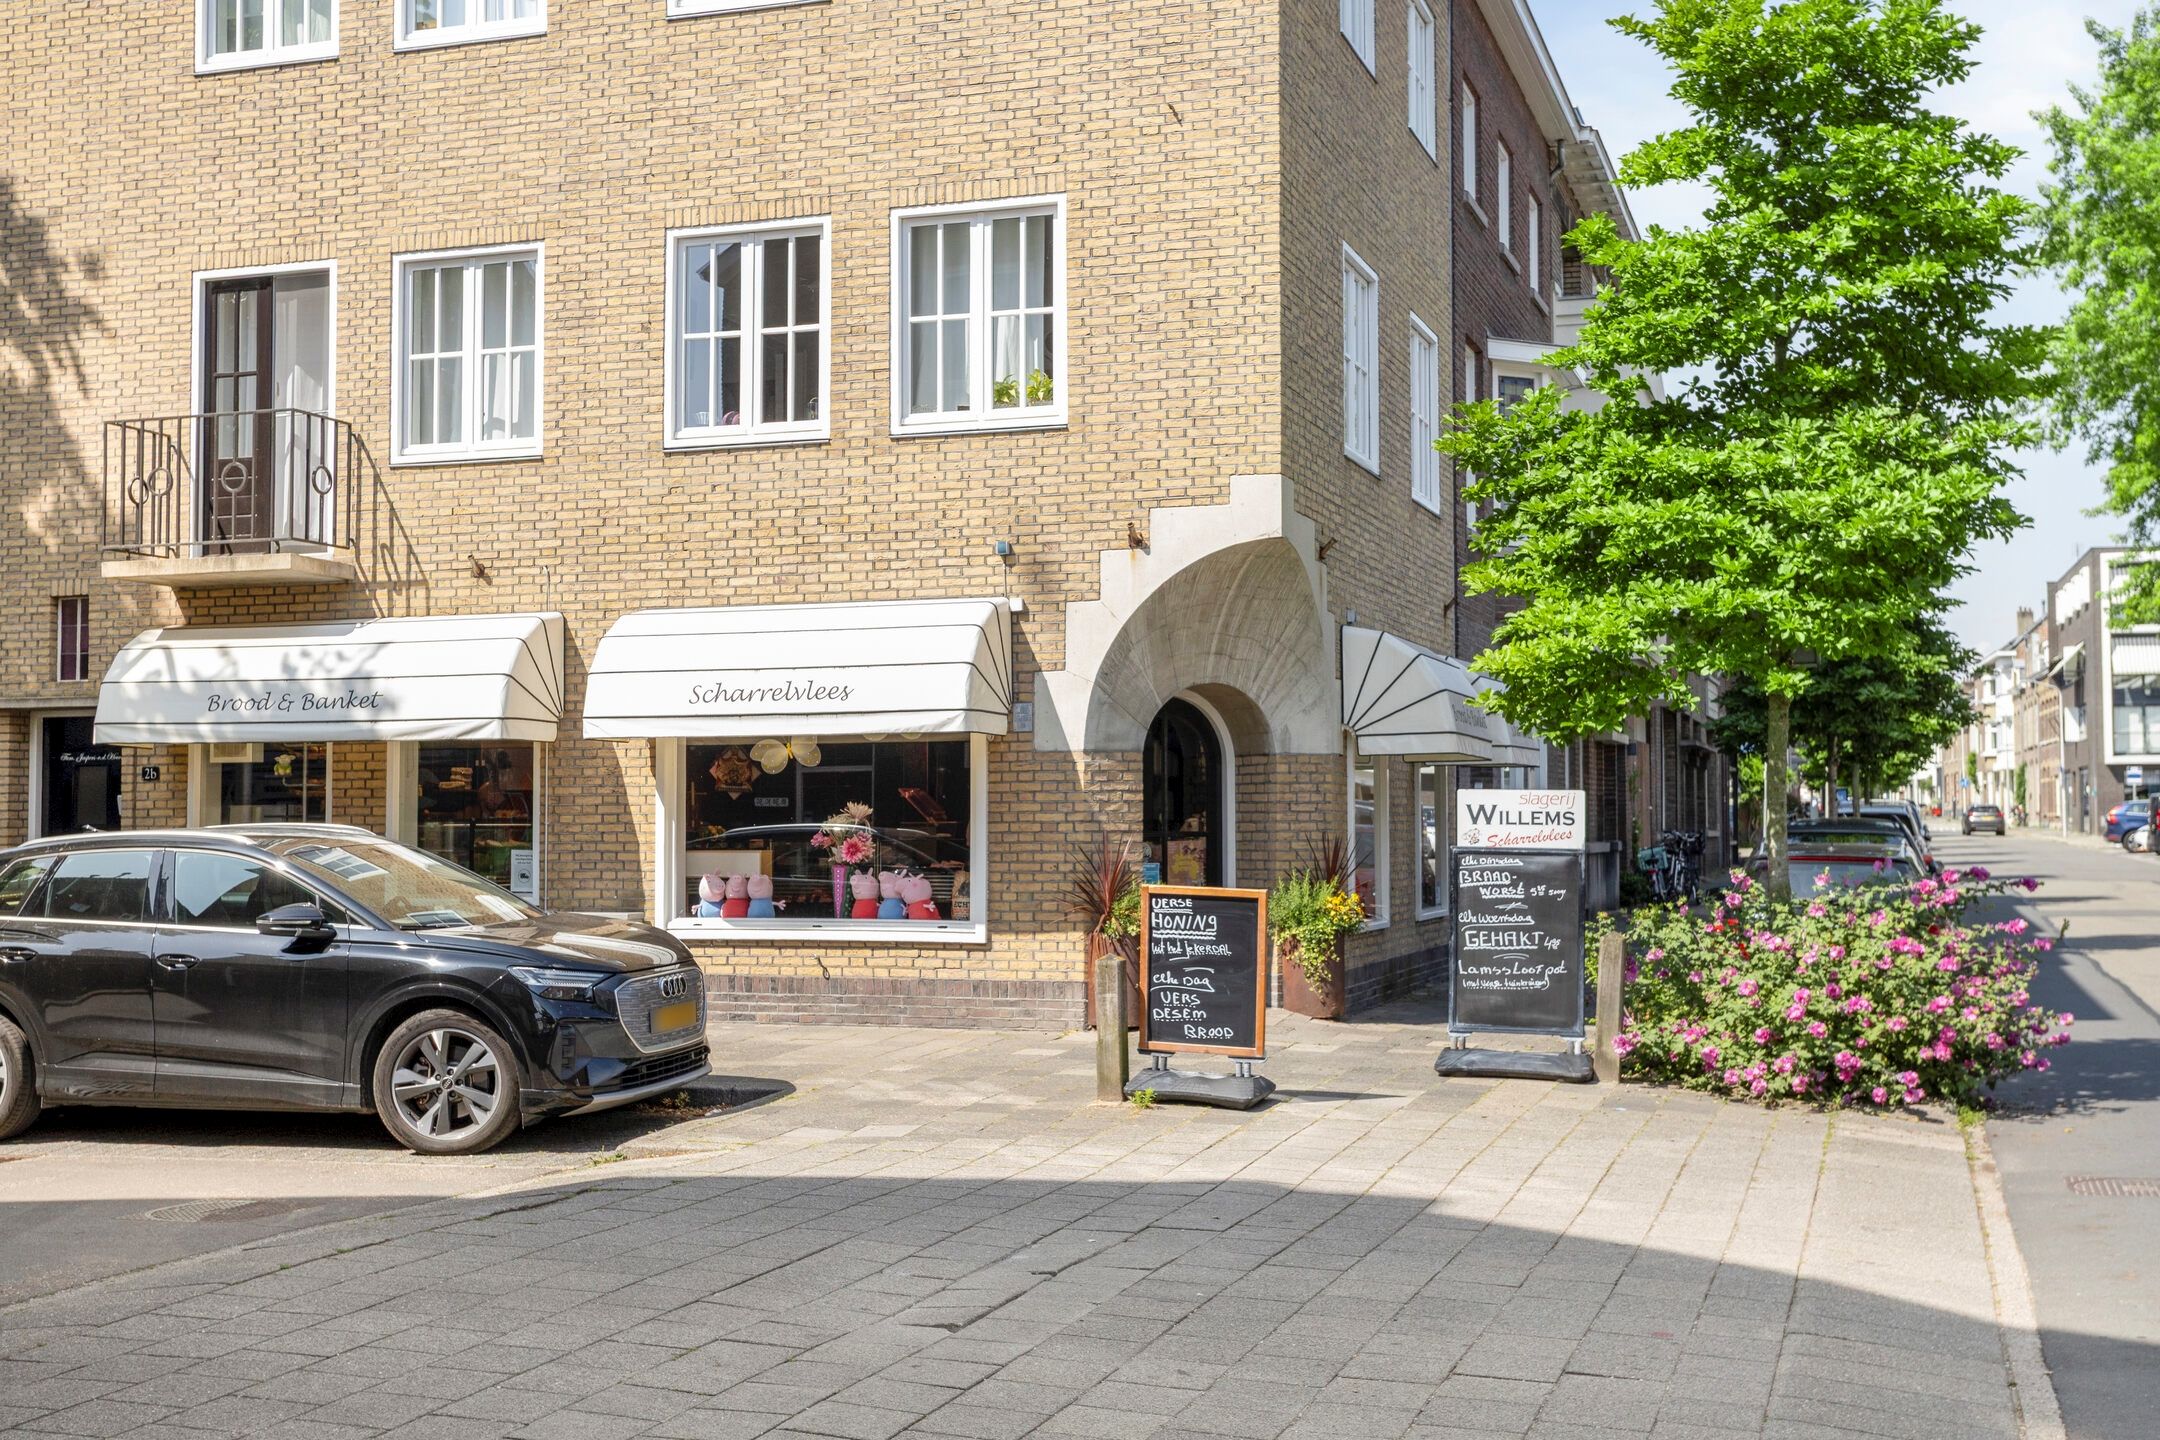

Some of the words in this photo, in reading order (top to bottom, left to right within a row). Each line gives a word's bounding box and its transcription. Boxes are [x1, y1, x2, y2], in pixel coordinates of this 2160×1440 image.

[207, 691, 276, 712] Brood
[277, 693, 295, 713] &
[301, 690, 384, 711] Banket
[689, 680, 854, 704] Scharrelvlees
[144, 767, 158, 780] 2b
[1519, 791, 1577, 809] slagerij
[1466, 804, 1575, 826] WILLEMS
[1487, 828, 1573, 848] Scharrelvlees
[1464, 931, 1544, 947] GEHAKT
